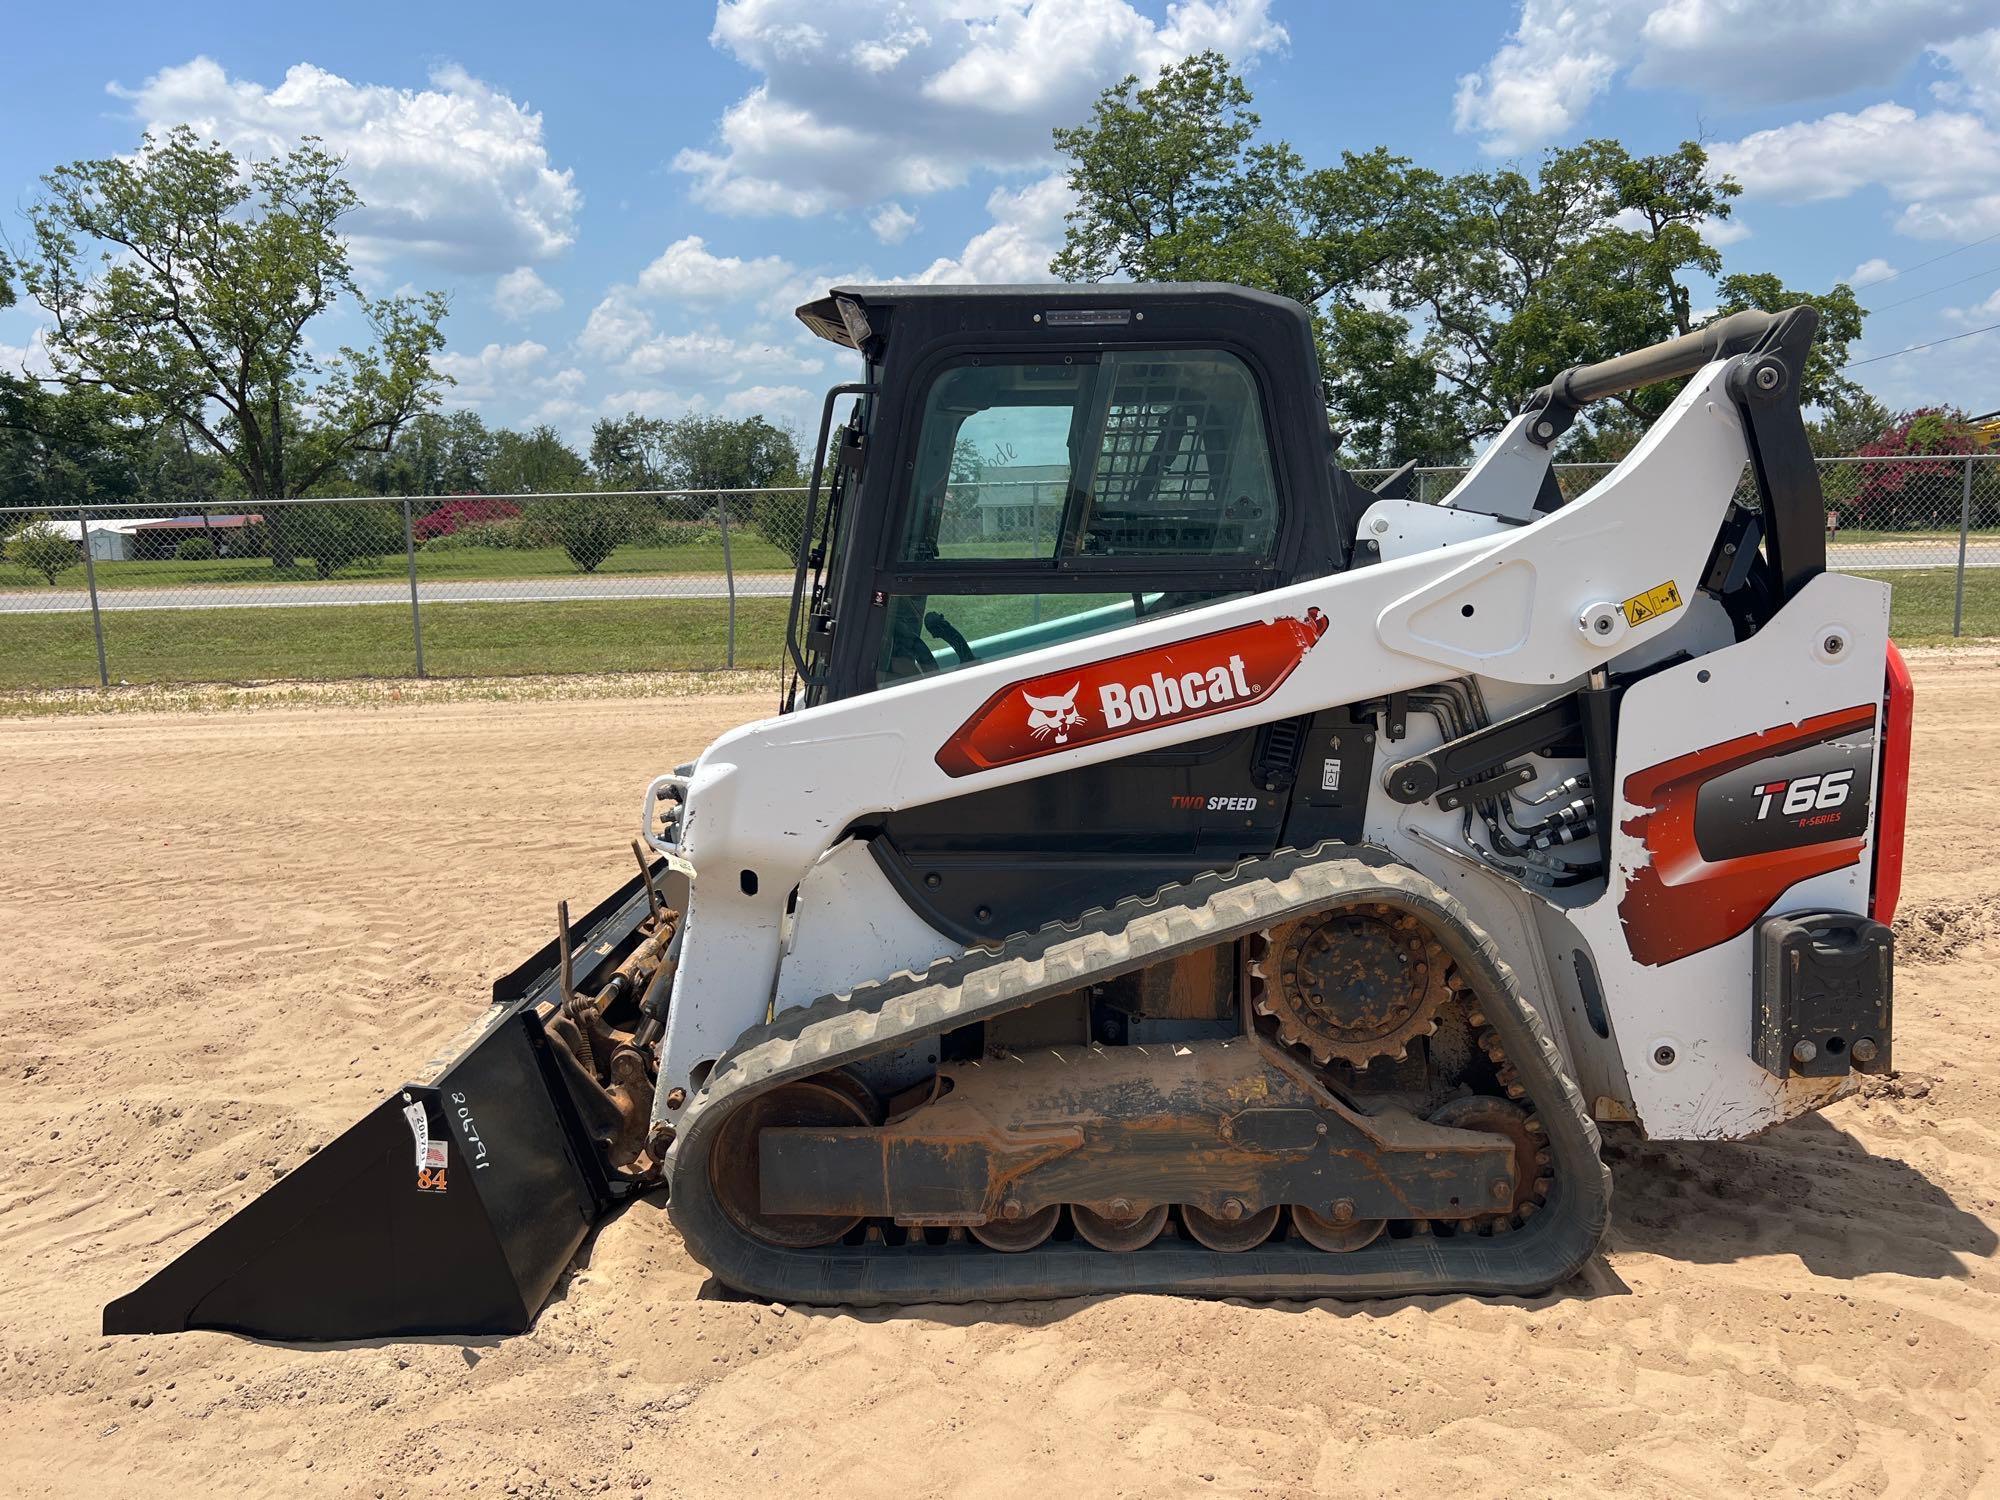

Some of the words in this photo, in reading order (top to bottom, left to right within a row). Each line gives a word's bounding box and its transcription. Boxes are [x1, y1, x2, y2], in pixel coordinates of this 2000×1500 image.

[1098, 653, 1251, 729] Bobcat
[1171, 796, 1206, 810] TWO
[1207, 796, 1258, 811] SPEED
[1752, 768, 1855, 820] T66
[1798, 812, 1841, 828] R-SERIES
[451, 1091, 490, 1169] 206791
[417, 1168, 447, 1190] 84
